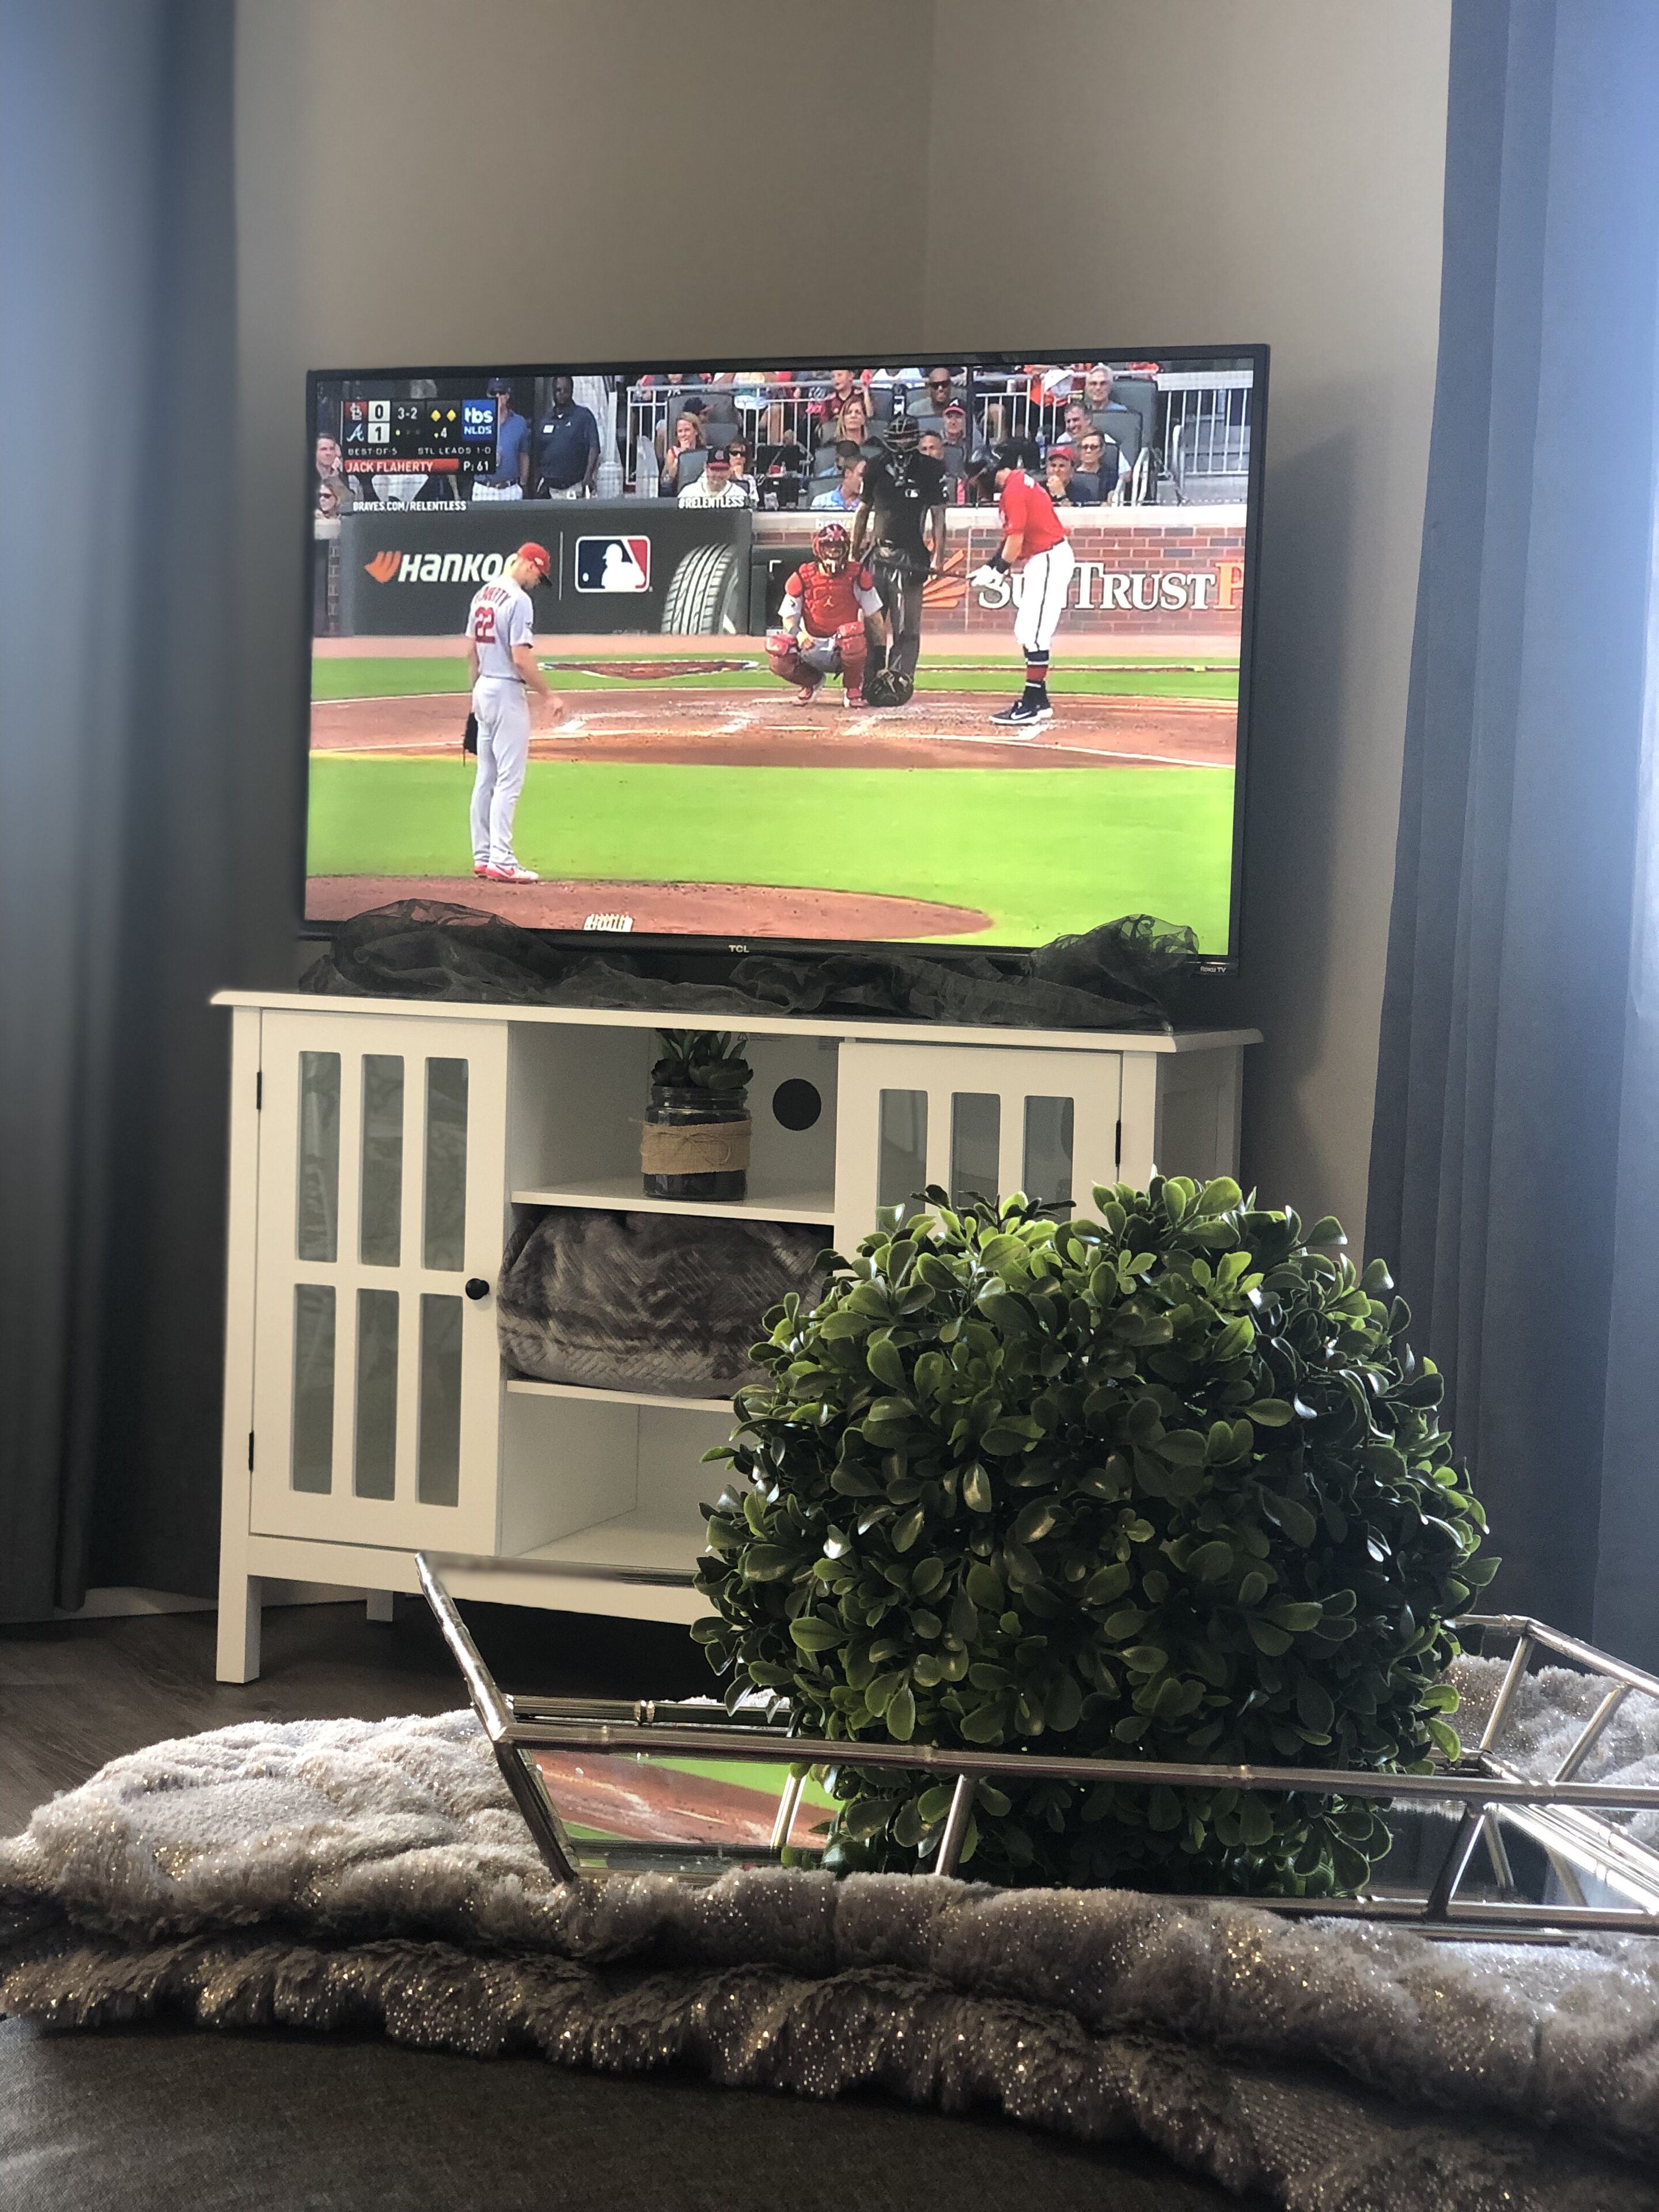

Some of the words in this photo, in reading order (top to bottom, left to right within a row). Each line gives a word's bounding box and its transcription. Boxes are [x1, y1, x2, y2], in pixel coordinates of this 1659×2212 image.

[375, 404, 384, 419] 0
[397, 407, 417, 419] 3-2
[464, 407, 493, 423] tbs
[375, 426, 381, 441] 1
[464, 425, 492, 435] NLDS
[346, 461, 374, 473] JACK
[376, 461, 433, 472] FLAHERTY
[477, 461, 488, 471] 61
[353, 501, 467, 512] BRAVES.COM/RELENTLESS
[475, 606, 496, 644] 22
[729, 945, 749, 953] TCL
